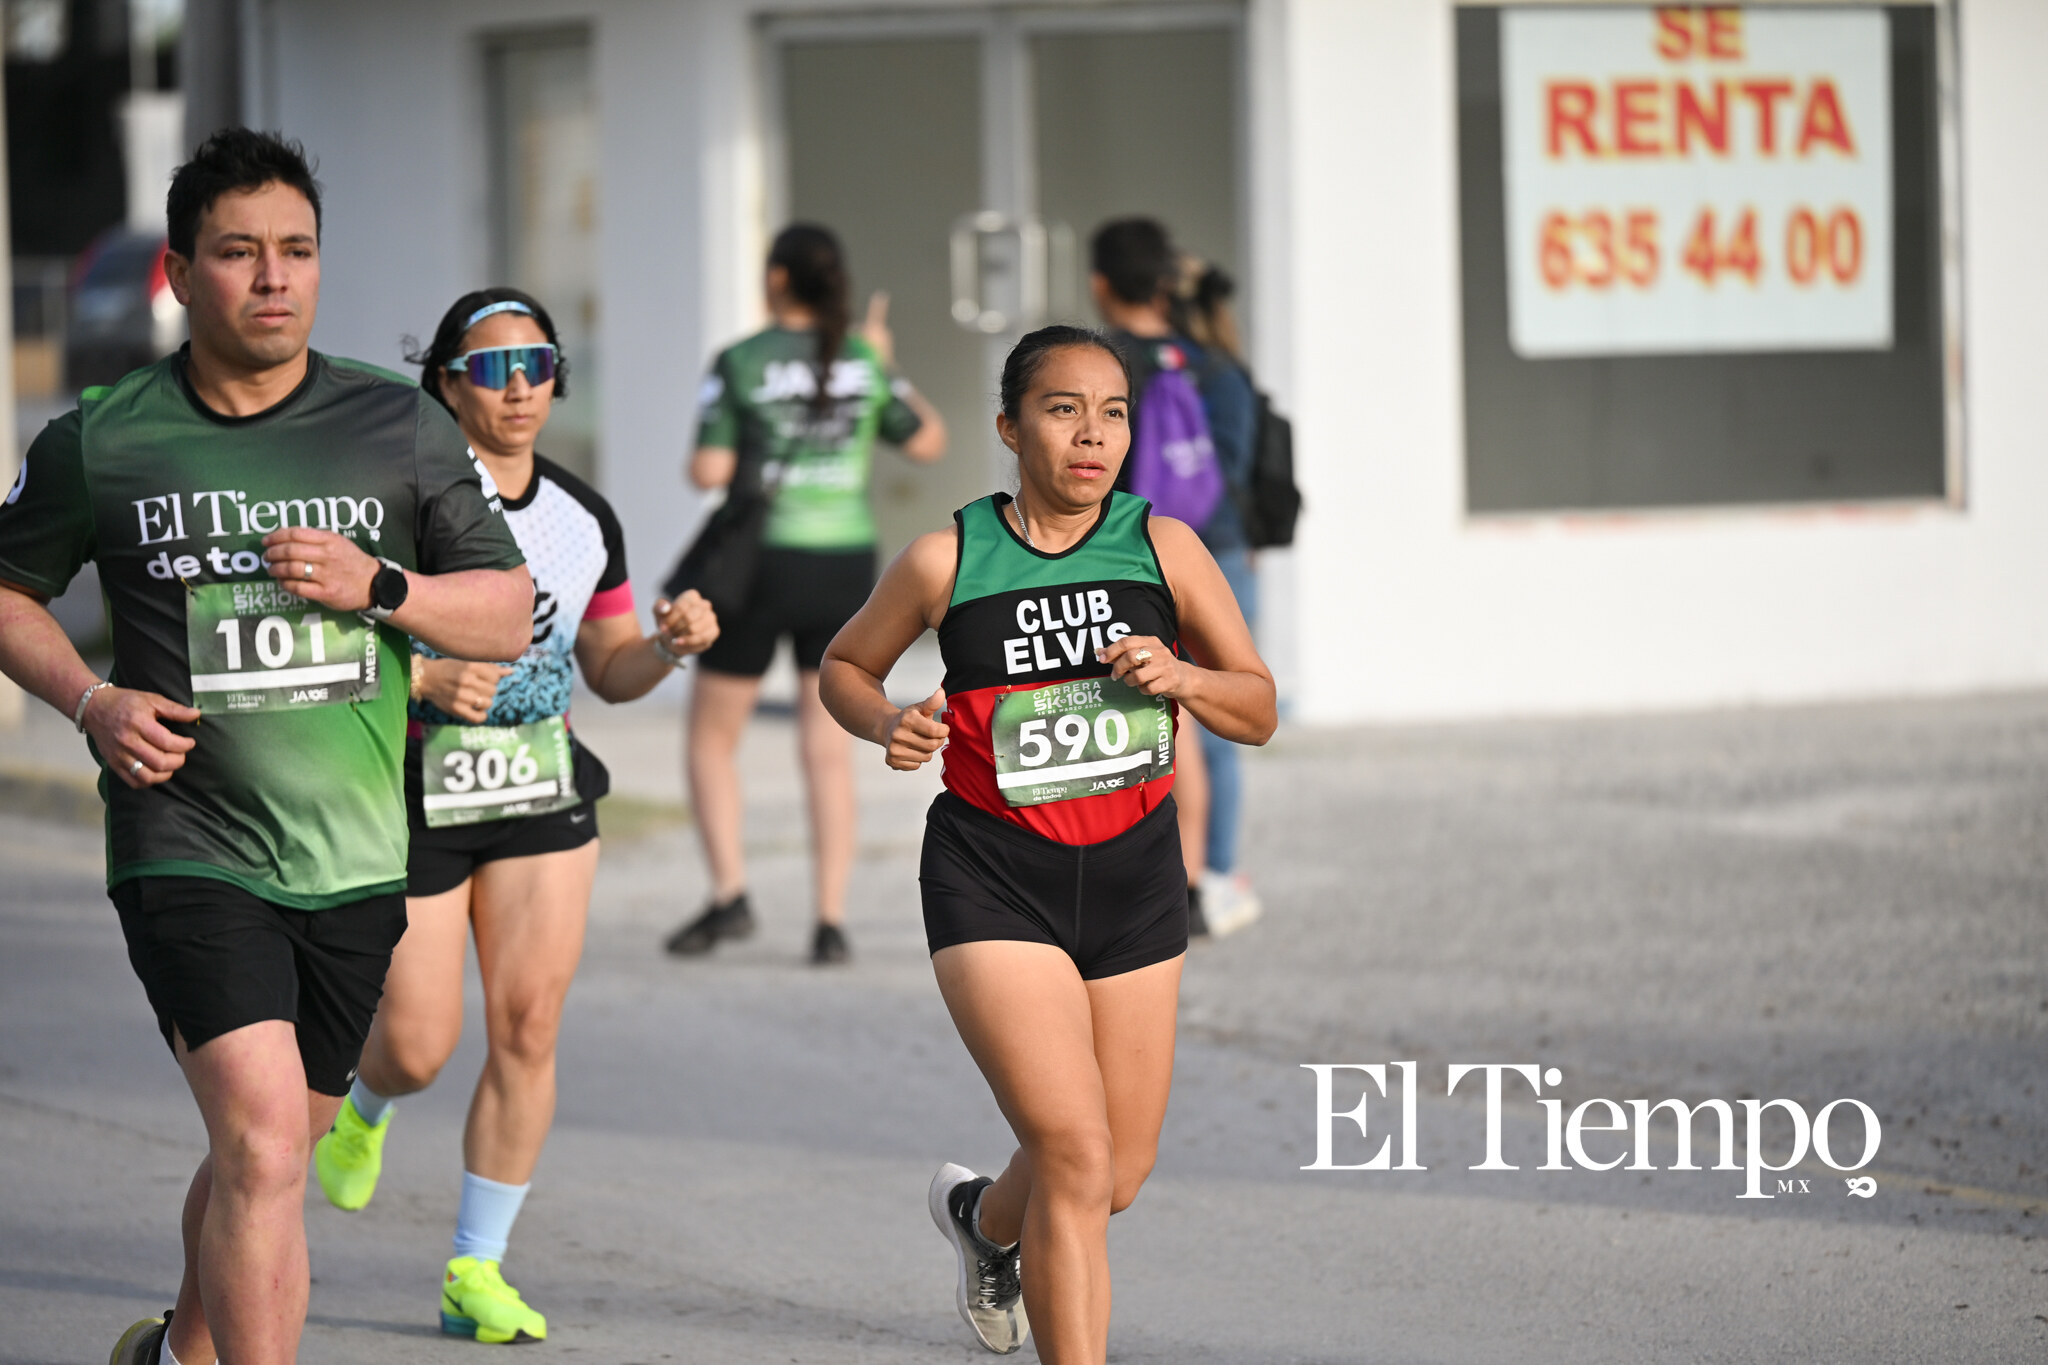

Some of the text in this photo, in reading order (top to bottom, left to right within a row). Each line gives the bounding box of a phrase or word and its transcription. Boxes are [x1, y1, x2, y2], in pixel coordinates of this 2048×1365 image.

[1655, 5, 1745, 62] SE
[1544, 79, 1856, 158] RENTA
[1539, 205, 1863, 291] 635 44 00
[131, 489, 384, 546] El Tiempo
[146, 551, 202, 580] de
[1016, 589, 1113, 634] CLUB
[216, 612, 326, 670] 101
[1033, 681, 1102, 700] CARRERA
[1019, 708, 1130, 767] 590
[1156, 693, 1170, 766] MEDALLA
[443, 743, 539, 793] 306
